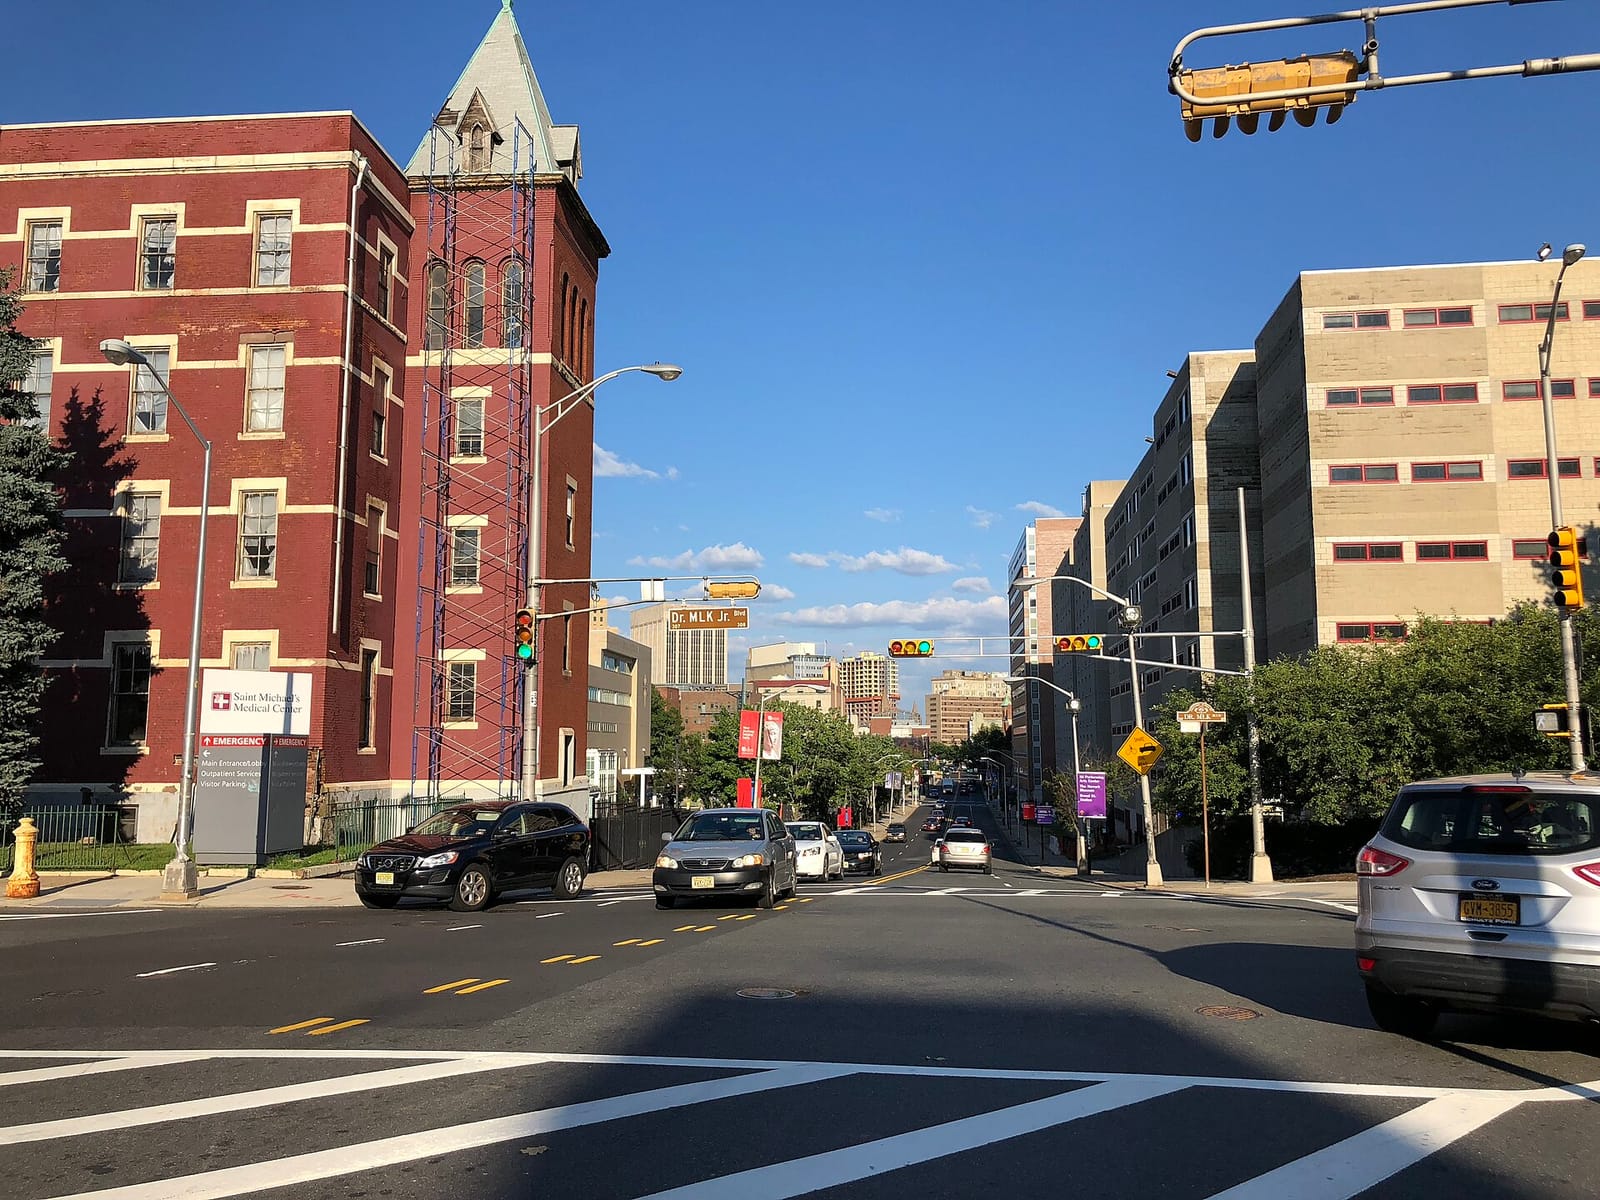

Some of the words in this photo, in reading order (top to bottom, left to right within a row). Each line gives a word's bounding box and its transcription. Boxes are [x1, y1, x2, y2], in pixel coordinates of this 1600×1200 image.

[671, 611, 686, 623] Dr.
[689, 610, 714, 623] MLK
[717, 610, 731, 622] Jr.
[233, 692, 256, 701] Saint
[259, 693, 300, 702] Michael's
[233, 703, 270, 713] Medical
[272, 704, 302, 713] Center
[213, 737, 267, 745] EMERGENCY
[279, 738, 306, 746] EMERGENCY
[201, 770, 235, 778] Outpatient
[221, 780, 247, 789] Parking
